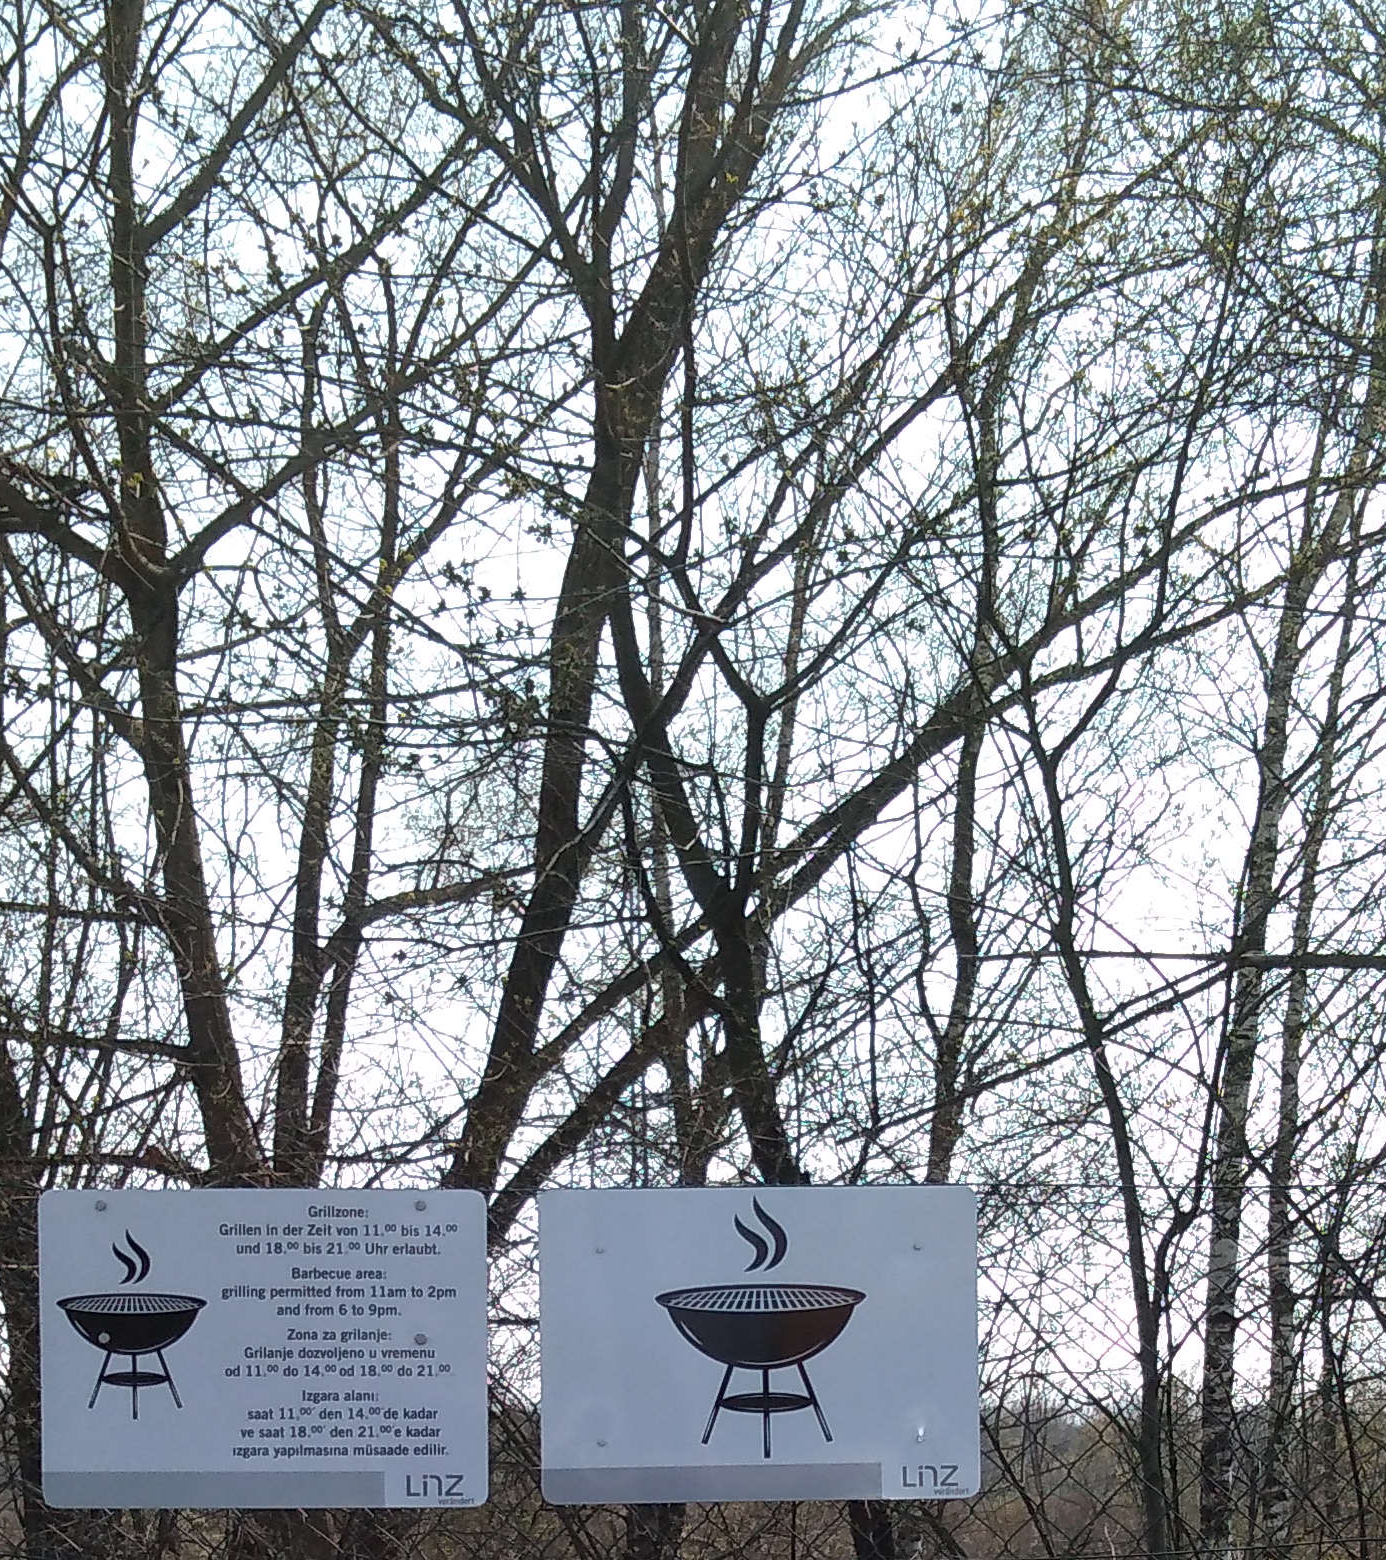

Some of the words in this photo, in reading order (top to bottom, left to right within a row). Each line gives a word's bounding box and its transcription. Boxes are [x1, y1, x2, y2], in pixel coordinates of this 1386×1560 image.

[308, 1205, 368, 1218] Grillzone:
[219, 1224, 261, 1236] Grillen
[266, 1224, 278, 1236] in
[283, 1224, 303, 1236] der
[307, 1224, 332, 1236] Zeit
[336, 1227, 358, 1236] von
[401, 1225, 419, 1236] bis
[237, 1242, 260, 1254] und
[303, 1242, 322, 1254] bis
[365, 1242, 388, 1255] Uhr
[392, 1243, 441, 1255] erlaubt.
[292, 1267, 351, 1280] Barbecue
[356, 1270, 386, 1280] area:
[222, 1285, 265, 1300] grilling
[270, 1285, 331, 1300] permitted
[336, 1285, 364, 1297] from
[370, 1285, 406, 1298] 11am
[411, 1286, 423, 1298] to
[427, 1286, 456, 1300] 2pm
[277, 1303, 300, 1316] and
[305, 1303, 334, 1316] from
[339, 1304, 347, 1316] 6
[352, 1304, 364, 1316] to
[368, 1304, 401, 1318] 9pm.
[287, 1328, 318, 1340] Zona
[322, 1331, 336, 1340] za
[341, 1328, 391, 1343] grilanje:
[244, 1346, 293, 1361] Grilanje
[298, 1347, 364, 1361] dozvoljeno
[369, 1350, 376, 1358] u
[381, 1349, 435, 1359] vremenu
[225, 1365, 240, 1377] od
[283, 1365, 299, 1377] do
[339, 1365, 354, 1377] od
[397, 1365, 412, 1377] do
[302, 1390, 339, 1404] Izgara
[248, 1408, 273, 1420] saat
[319, 1408, 342, 1420] den
[403, 1407, 438, 1421] kadar
[241, 1429, 254, 1438] ve
[259, 1427, 284, 1438] saat
[330, 1426, 353, 1438] den
[406, 1426, 441, 1437] kadar
[353, 1444, 409, 1456] müsaade
[414, 1443, 448, 1456] edilir.
